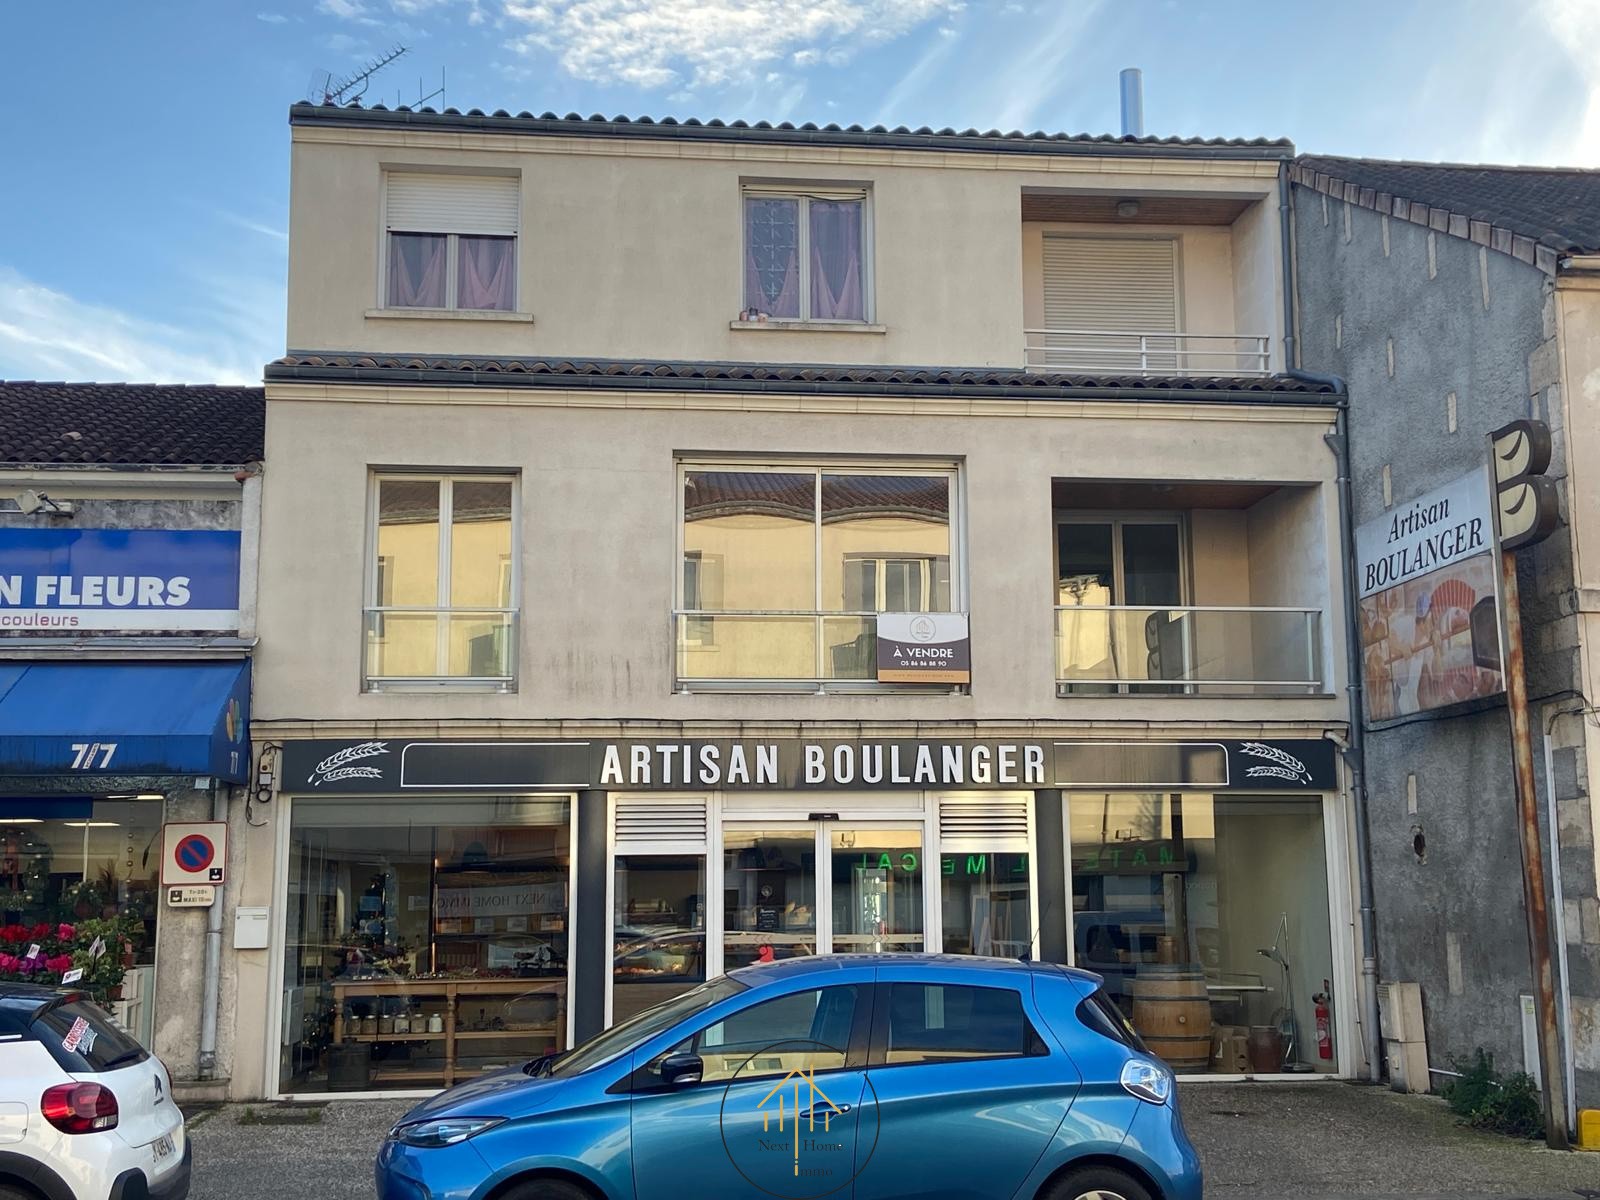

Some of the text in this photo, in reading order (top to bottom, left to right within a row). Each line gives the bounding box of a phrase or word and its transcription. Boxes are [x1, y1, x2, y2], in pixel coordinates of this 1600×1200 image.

[1387, 499, 1449, 544] Artisan
[1365, 517, 1484, 592] BOULANGER
[35, 575, 191, 607] FLEURS
[1, 613, 79, 626] couleurs
[893, 645, 954, 658] À VENDRE
[71, 743, 118, 769] 7/7
[600, 744, 1046, 784] ARTISAN BOULANGER
